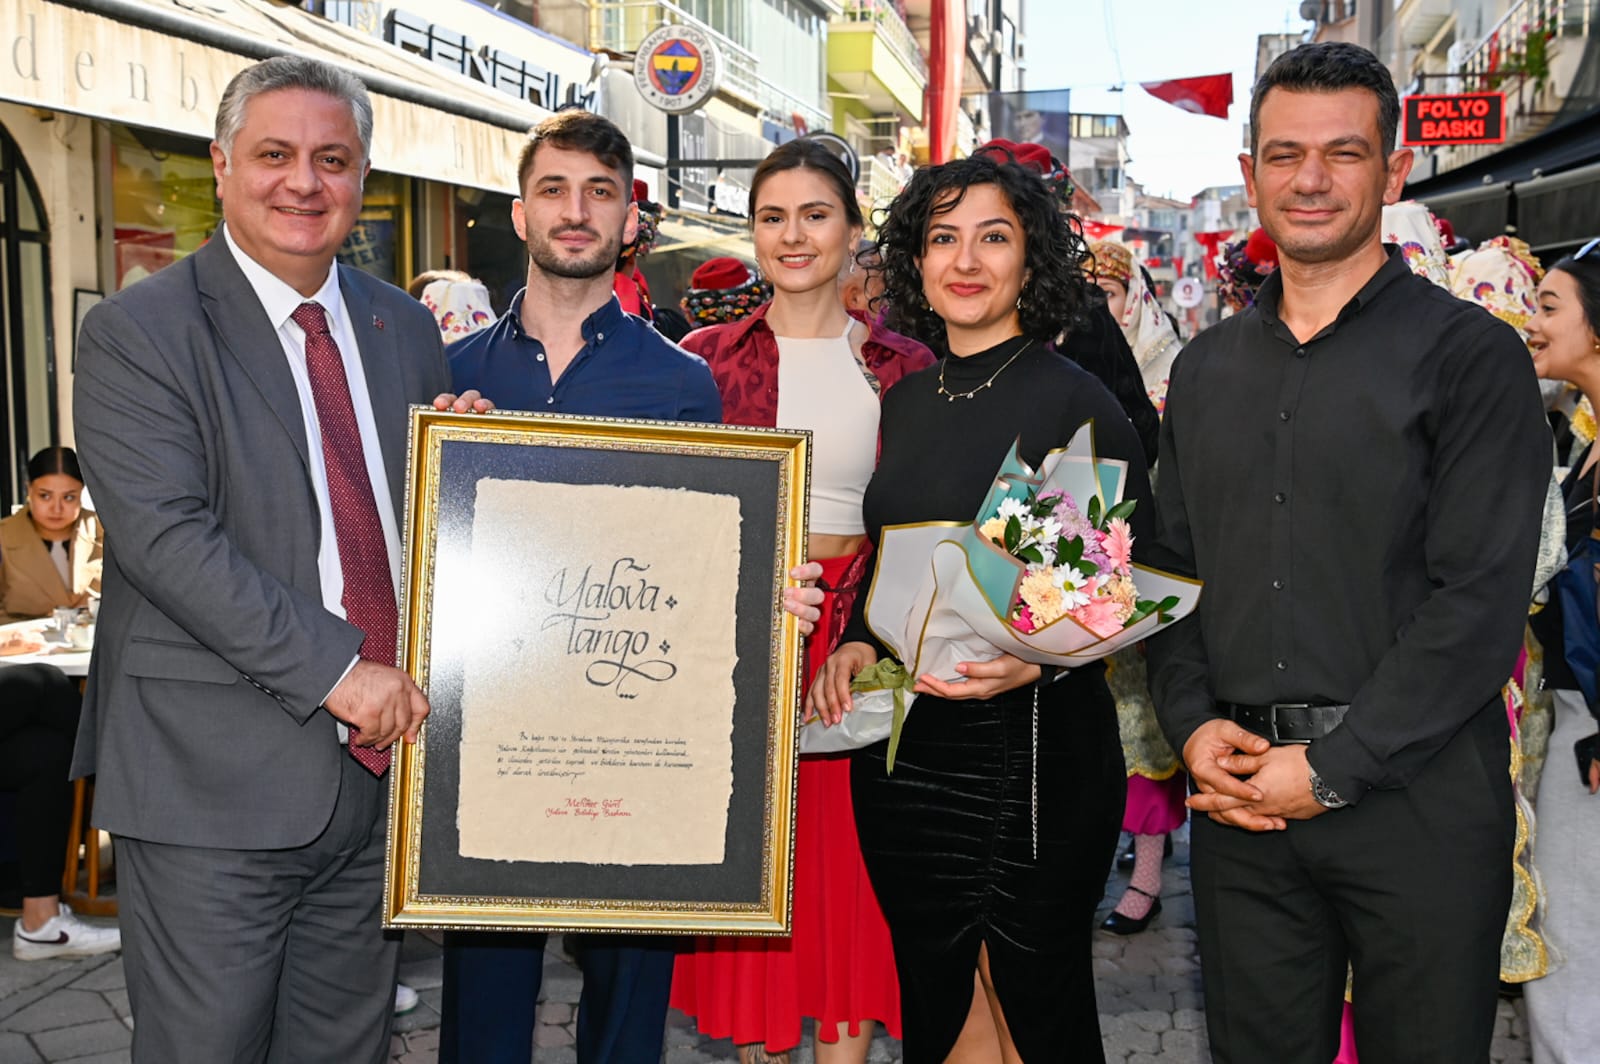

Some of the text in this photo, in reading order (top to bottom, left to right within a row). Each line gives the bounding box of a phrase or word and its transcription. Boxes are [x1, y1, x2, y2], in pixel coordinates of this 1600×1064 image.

[637, 28, 673, 89] FENERBAHÇE
[678, 28, 706, 48] SPOR
[659, 95, 682, 107] 1907
[1417, 99, 1490, 119] FOLYO
[1421, 119, 1485, 139] BASKI
[544, 557, 660, 613] Yalova
